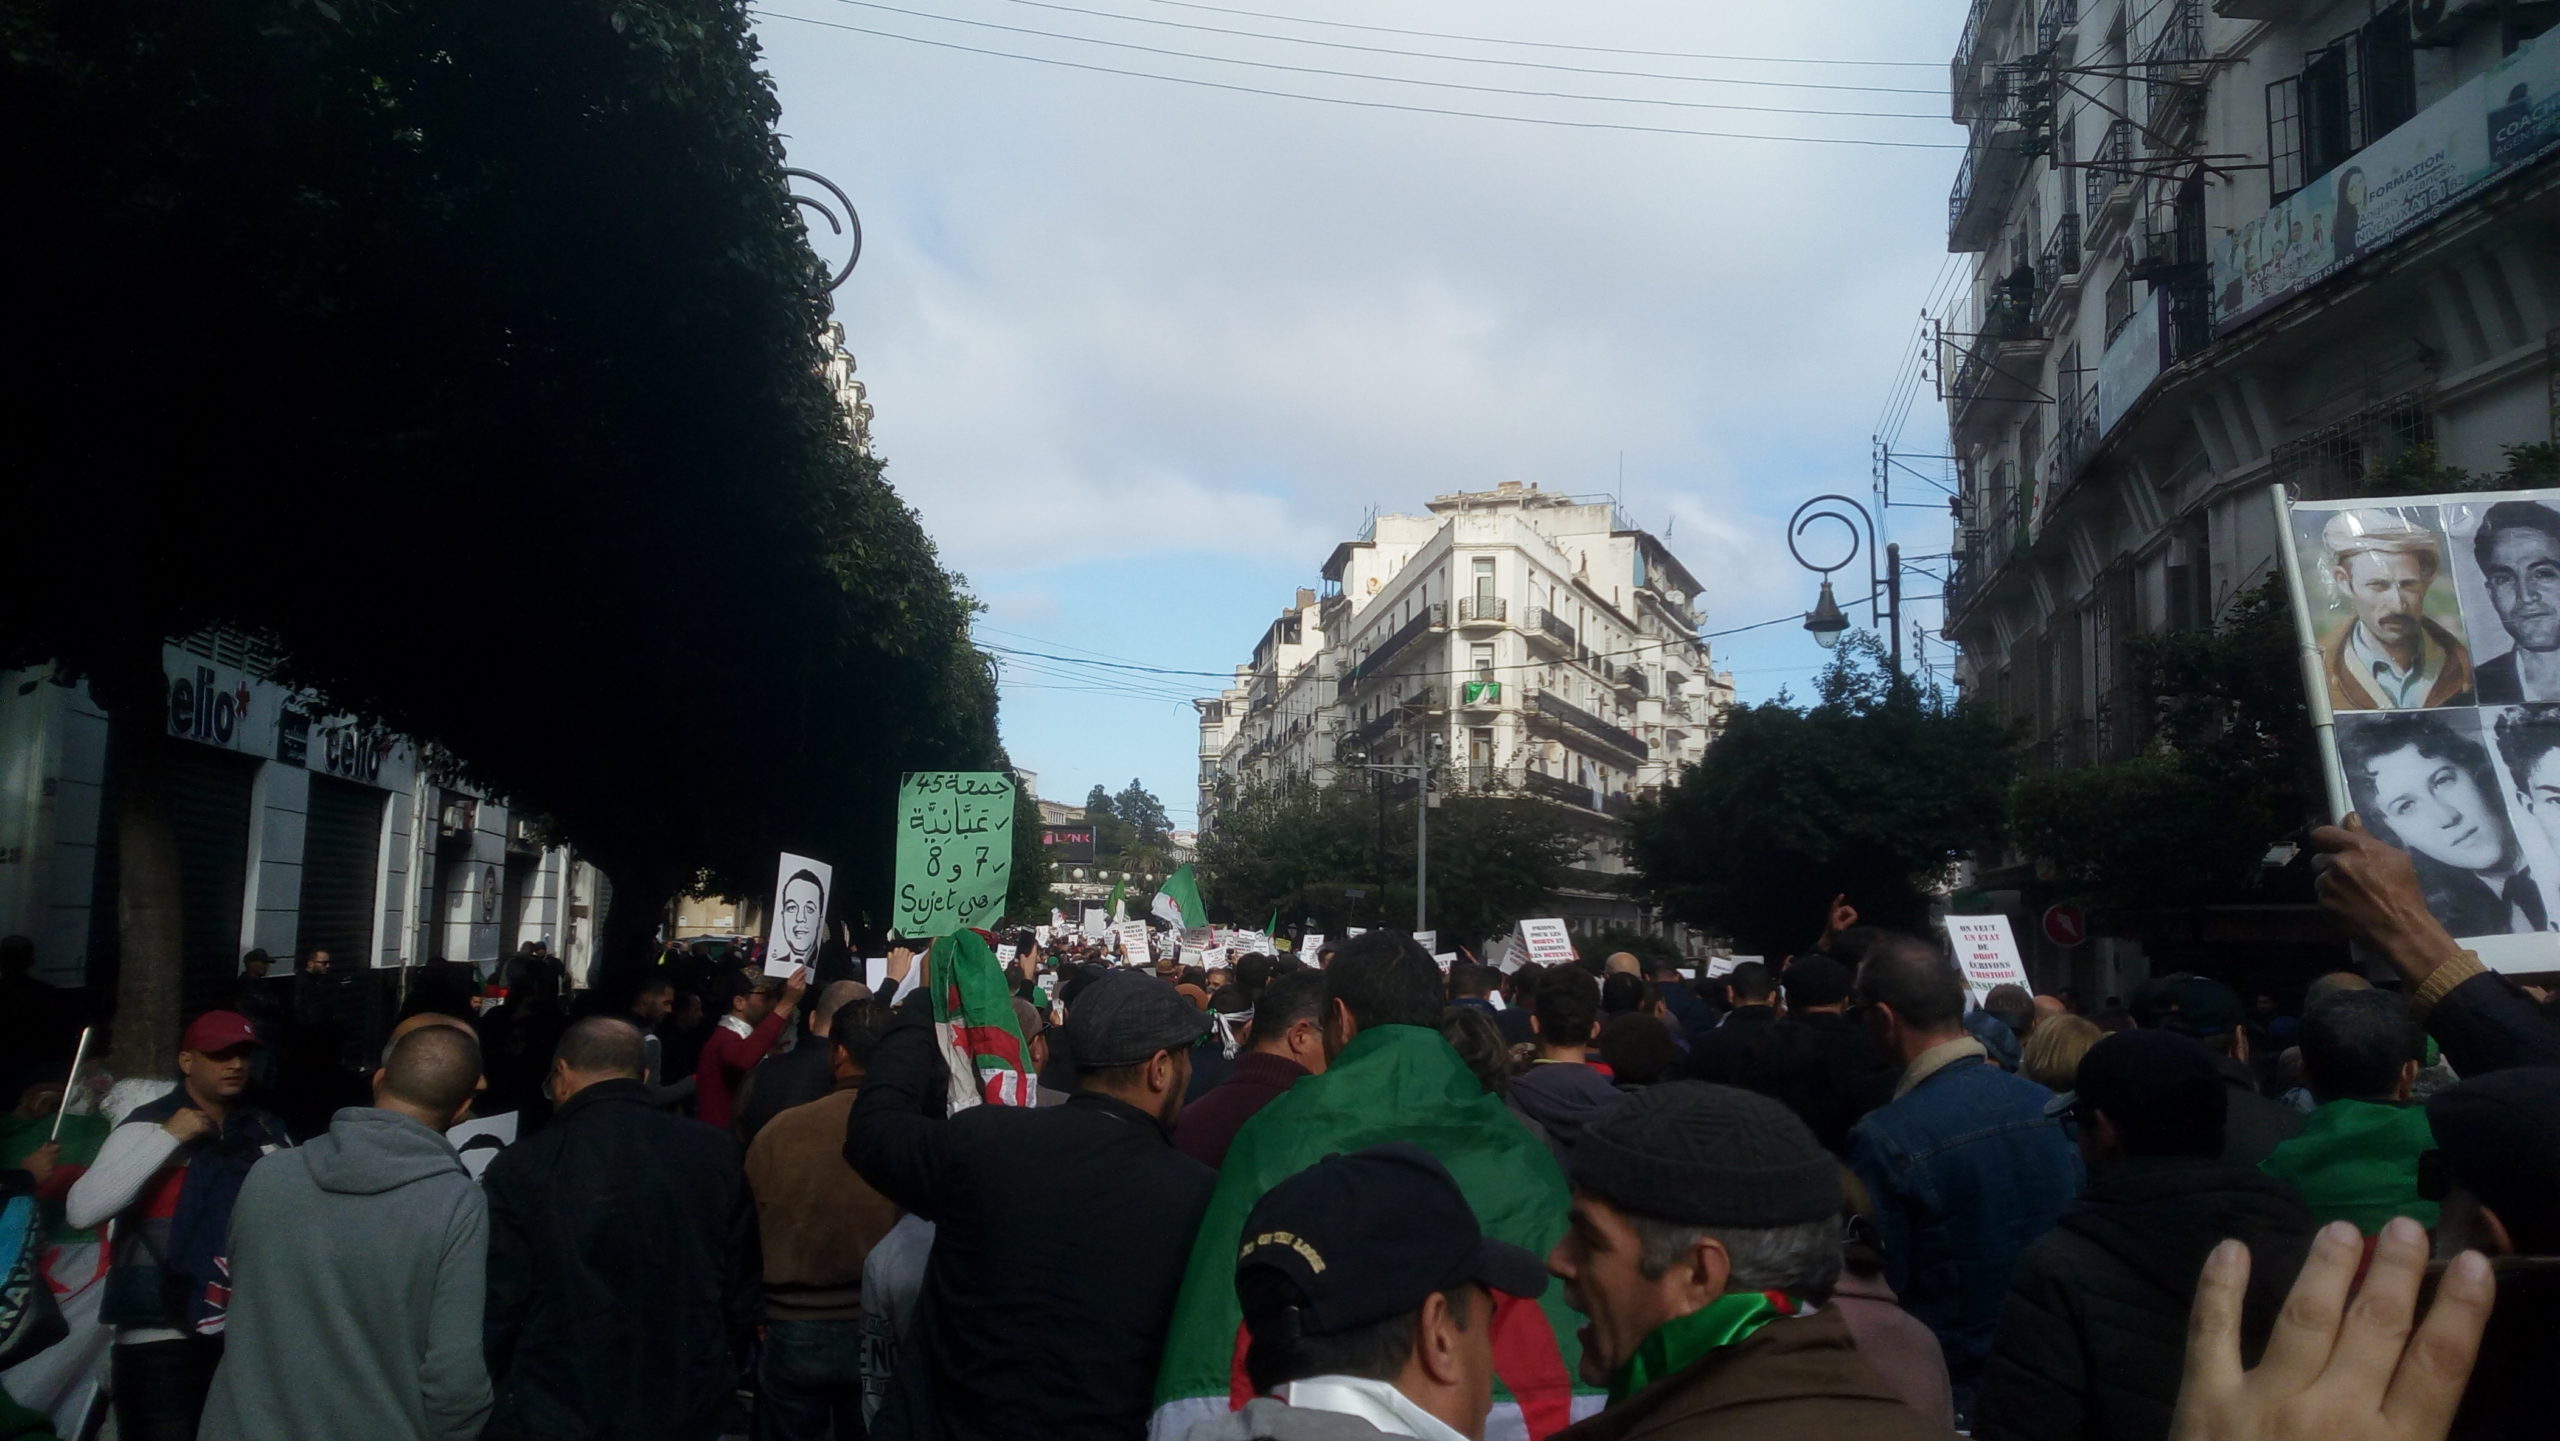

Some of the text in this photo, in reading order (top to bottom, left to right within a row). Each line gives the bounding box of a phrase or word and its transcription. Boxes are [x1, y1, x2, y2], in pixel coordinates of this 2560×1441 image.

[2368, 150, 2445, 203] FORMATION
[2408, 162, 2457, 195] Français
[2355, 206, 2411, 245] NIVEAUX
[161, 664, 235, 745] elio
[916, 773, 1010, 800] جمعة 45
[1055, 833, 1091, 843] LYNX
[926, 845, 990, 882] 7 و 8
[900, 883, 956, 925] Sujet
[1973, 924, 1997, 932] VEUT
[1973, 952, 1999, 960] DROIT
[1977, 943, 1989, 951] DE
